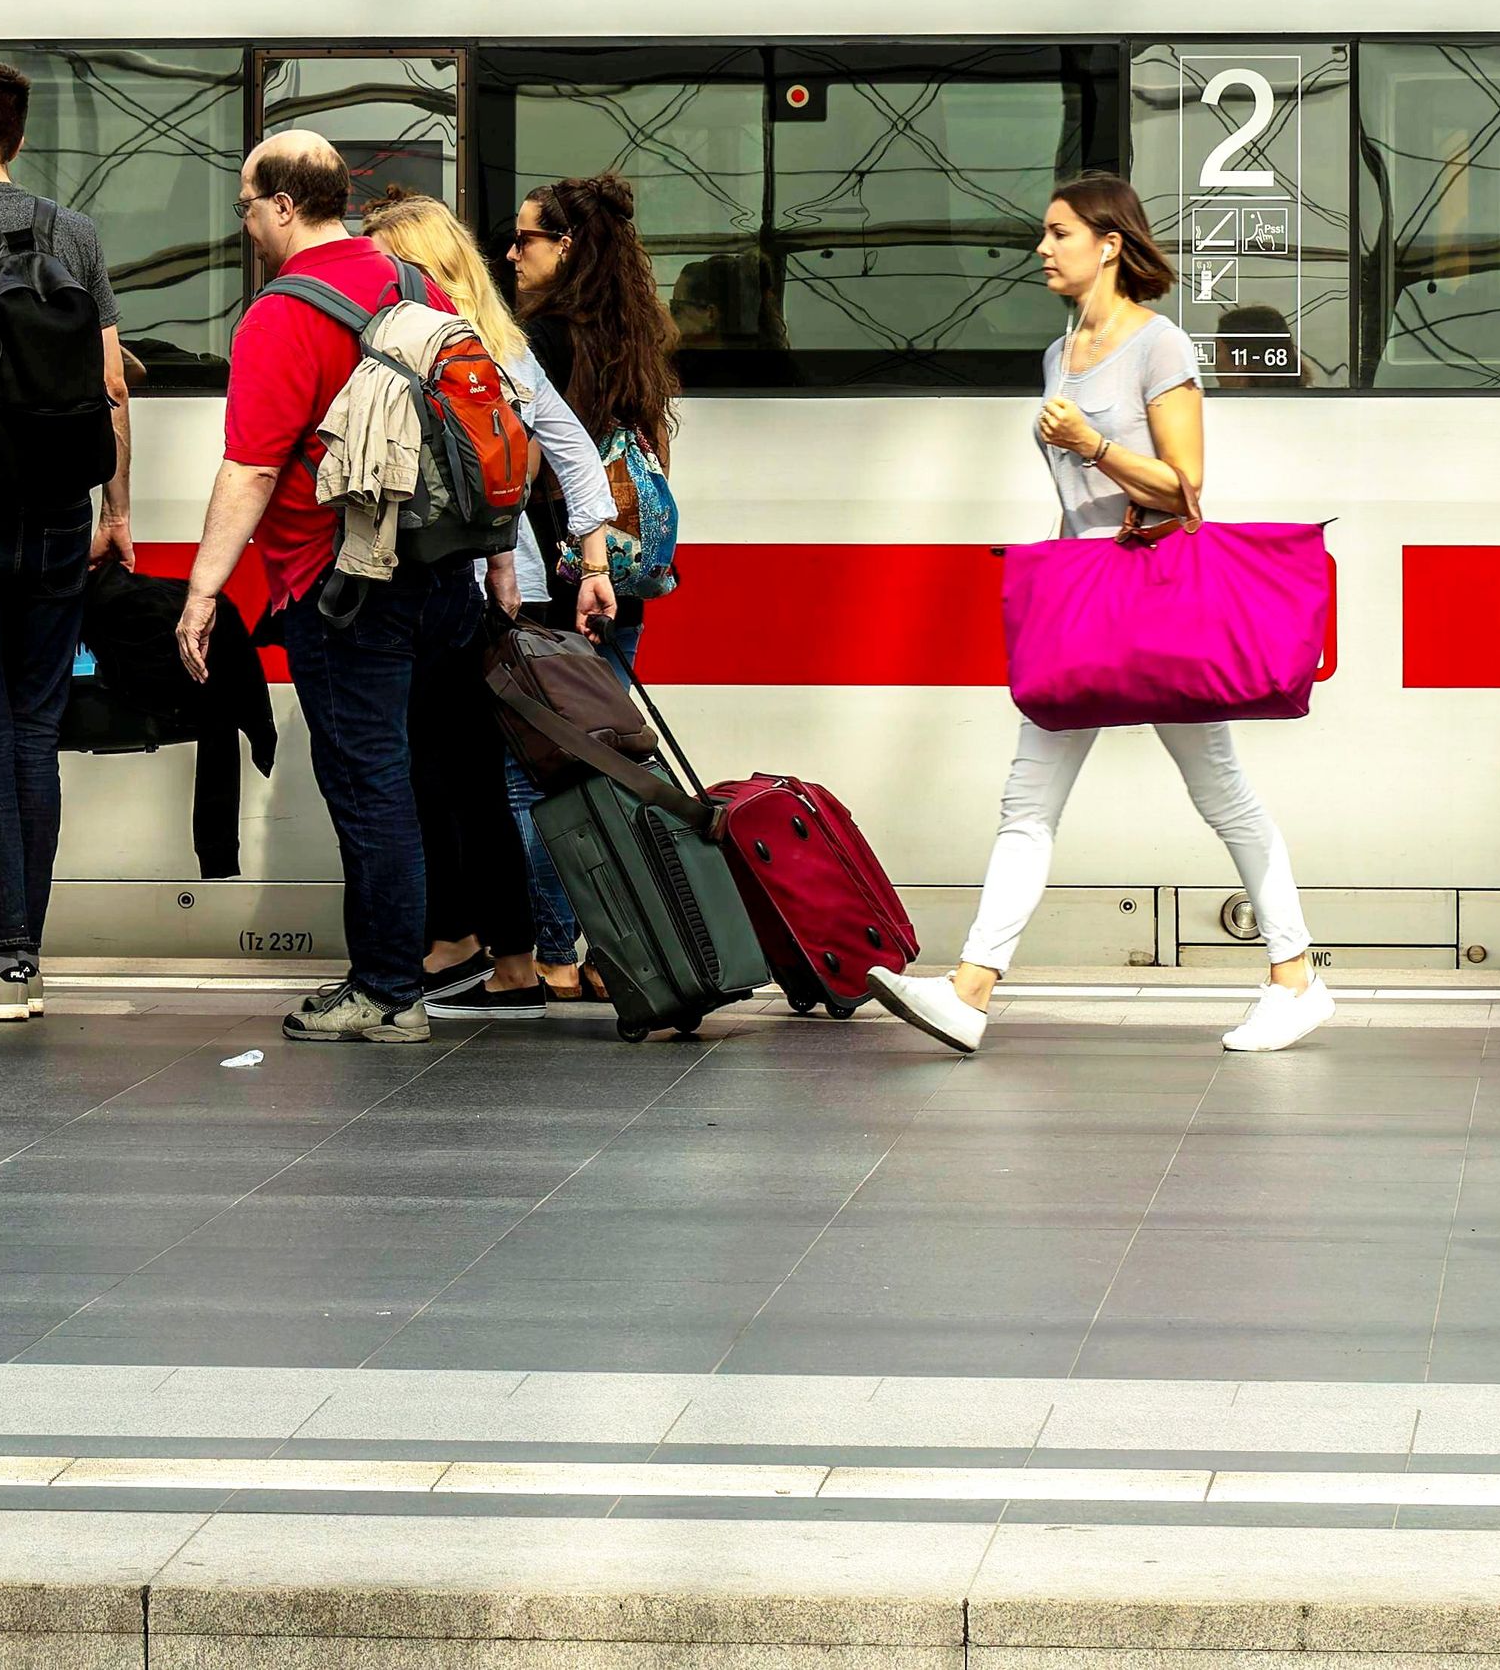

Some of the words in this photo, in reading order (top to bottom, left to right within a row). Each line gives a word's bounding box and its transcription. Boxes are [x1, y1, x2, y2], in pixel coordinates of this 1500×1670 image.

[1199, 68, 1274, 186] 2
[1264, 224, 1284, 234] Psst
[1231, 350, 1247, 364] 11
[1264, 349, 1287, 364] 68
[239, 930, 263, 951] (Tz
[269, 931, 313, 953] 237)
[1312, 951, 1332, 967] WC
[9, 971, 25, 979] FILA
